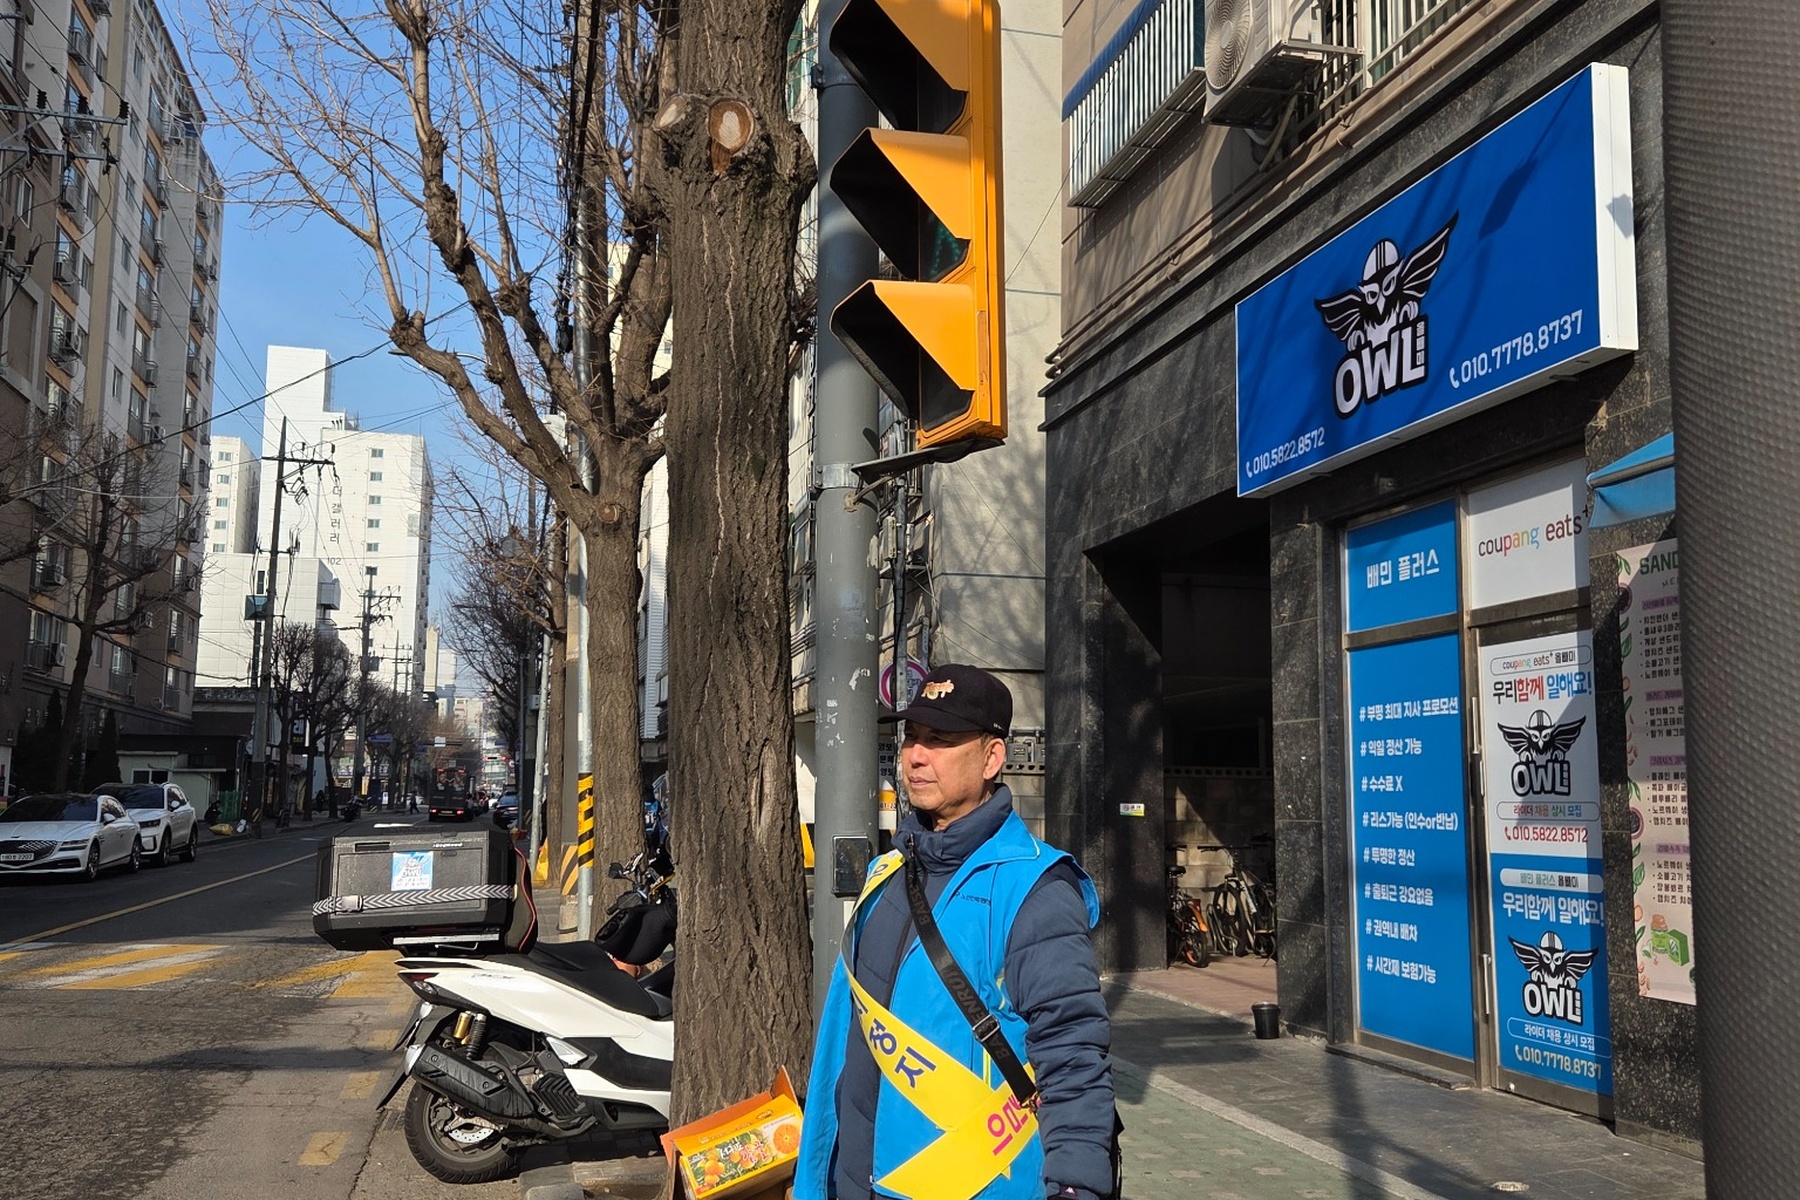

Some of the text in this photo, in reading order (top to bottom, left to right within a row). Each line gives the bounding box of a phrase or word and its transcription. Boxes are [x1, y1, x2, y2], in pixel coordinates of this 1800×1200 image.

[1461, 309, 1583, 383] 010.7778.8737
[1335, 327, 1425, 414] OWL
[1253, 427, 1325, 476] 010.5822.8572
[1478, 526, 1540, 557] coupang
[1367, 549, 1440, 589] 배민 플러스
[1493, 671, 1592, 705] 우리함께 일해요!
[1367, 704, 1384, 721] 부평
[1385, 702, 1402, 719] 최대
[1403, 700, 1421, 718] 지사
[1422, 697, 1459, 717] 프로모션
[1386, 738, 1403, 756] 정산
[1404, 738, 1422, 755] 가능
[1369, 775, 1394, 792] 수수료
[1395, 775, 1404, 792] X
[1513, 762, 1569, 795] OWL
[1370, 811, 1403, 829] 리스가능
[1514, 804, 1534, 817] 라이더
[1551, 804, 1566, 818] 상시
[1567, 804, 1582, 818] 모집
[1512, 825, 1588, 843] 010.5822.8572
[1371, 847, 1396, 865] 투명한
[1397, 848, 1415, 867] 정산
[1372, 883, 1397, 902] 출퇴근
[1399, 886, 1434, 906] 강요없음
[1503, 892, 1604, 927] 우리함께 일해요!
[1400, 923, 1418, 942] 배차
[1375, 956, 1399, 977] 시간제
[1401, 960, 1437, 984] 보험가능
[1524, 983, 1582, 1024] OWL
[1524, 1024, 1595, 1051] 라이더 채용 상시 모집
[1523, 1046, 1602, 1080] 010.7778.8737
